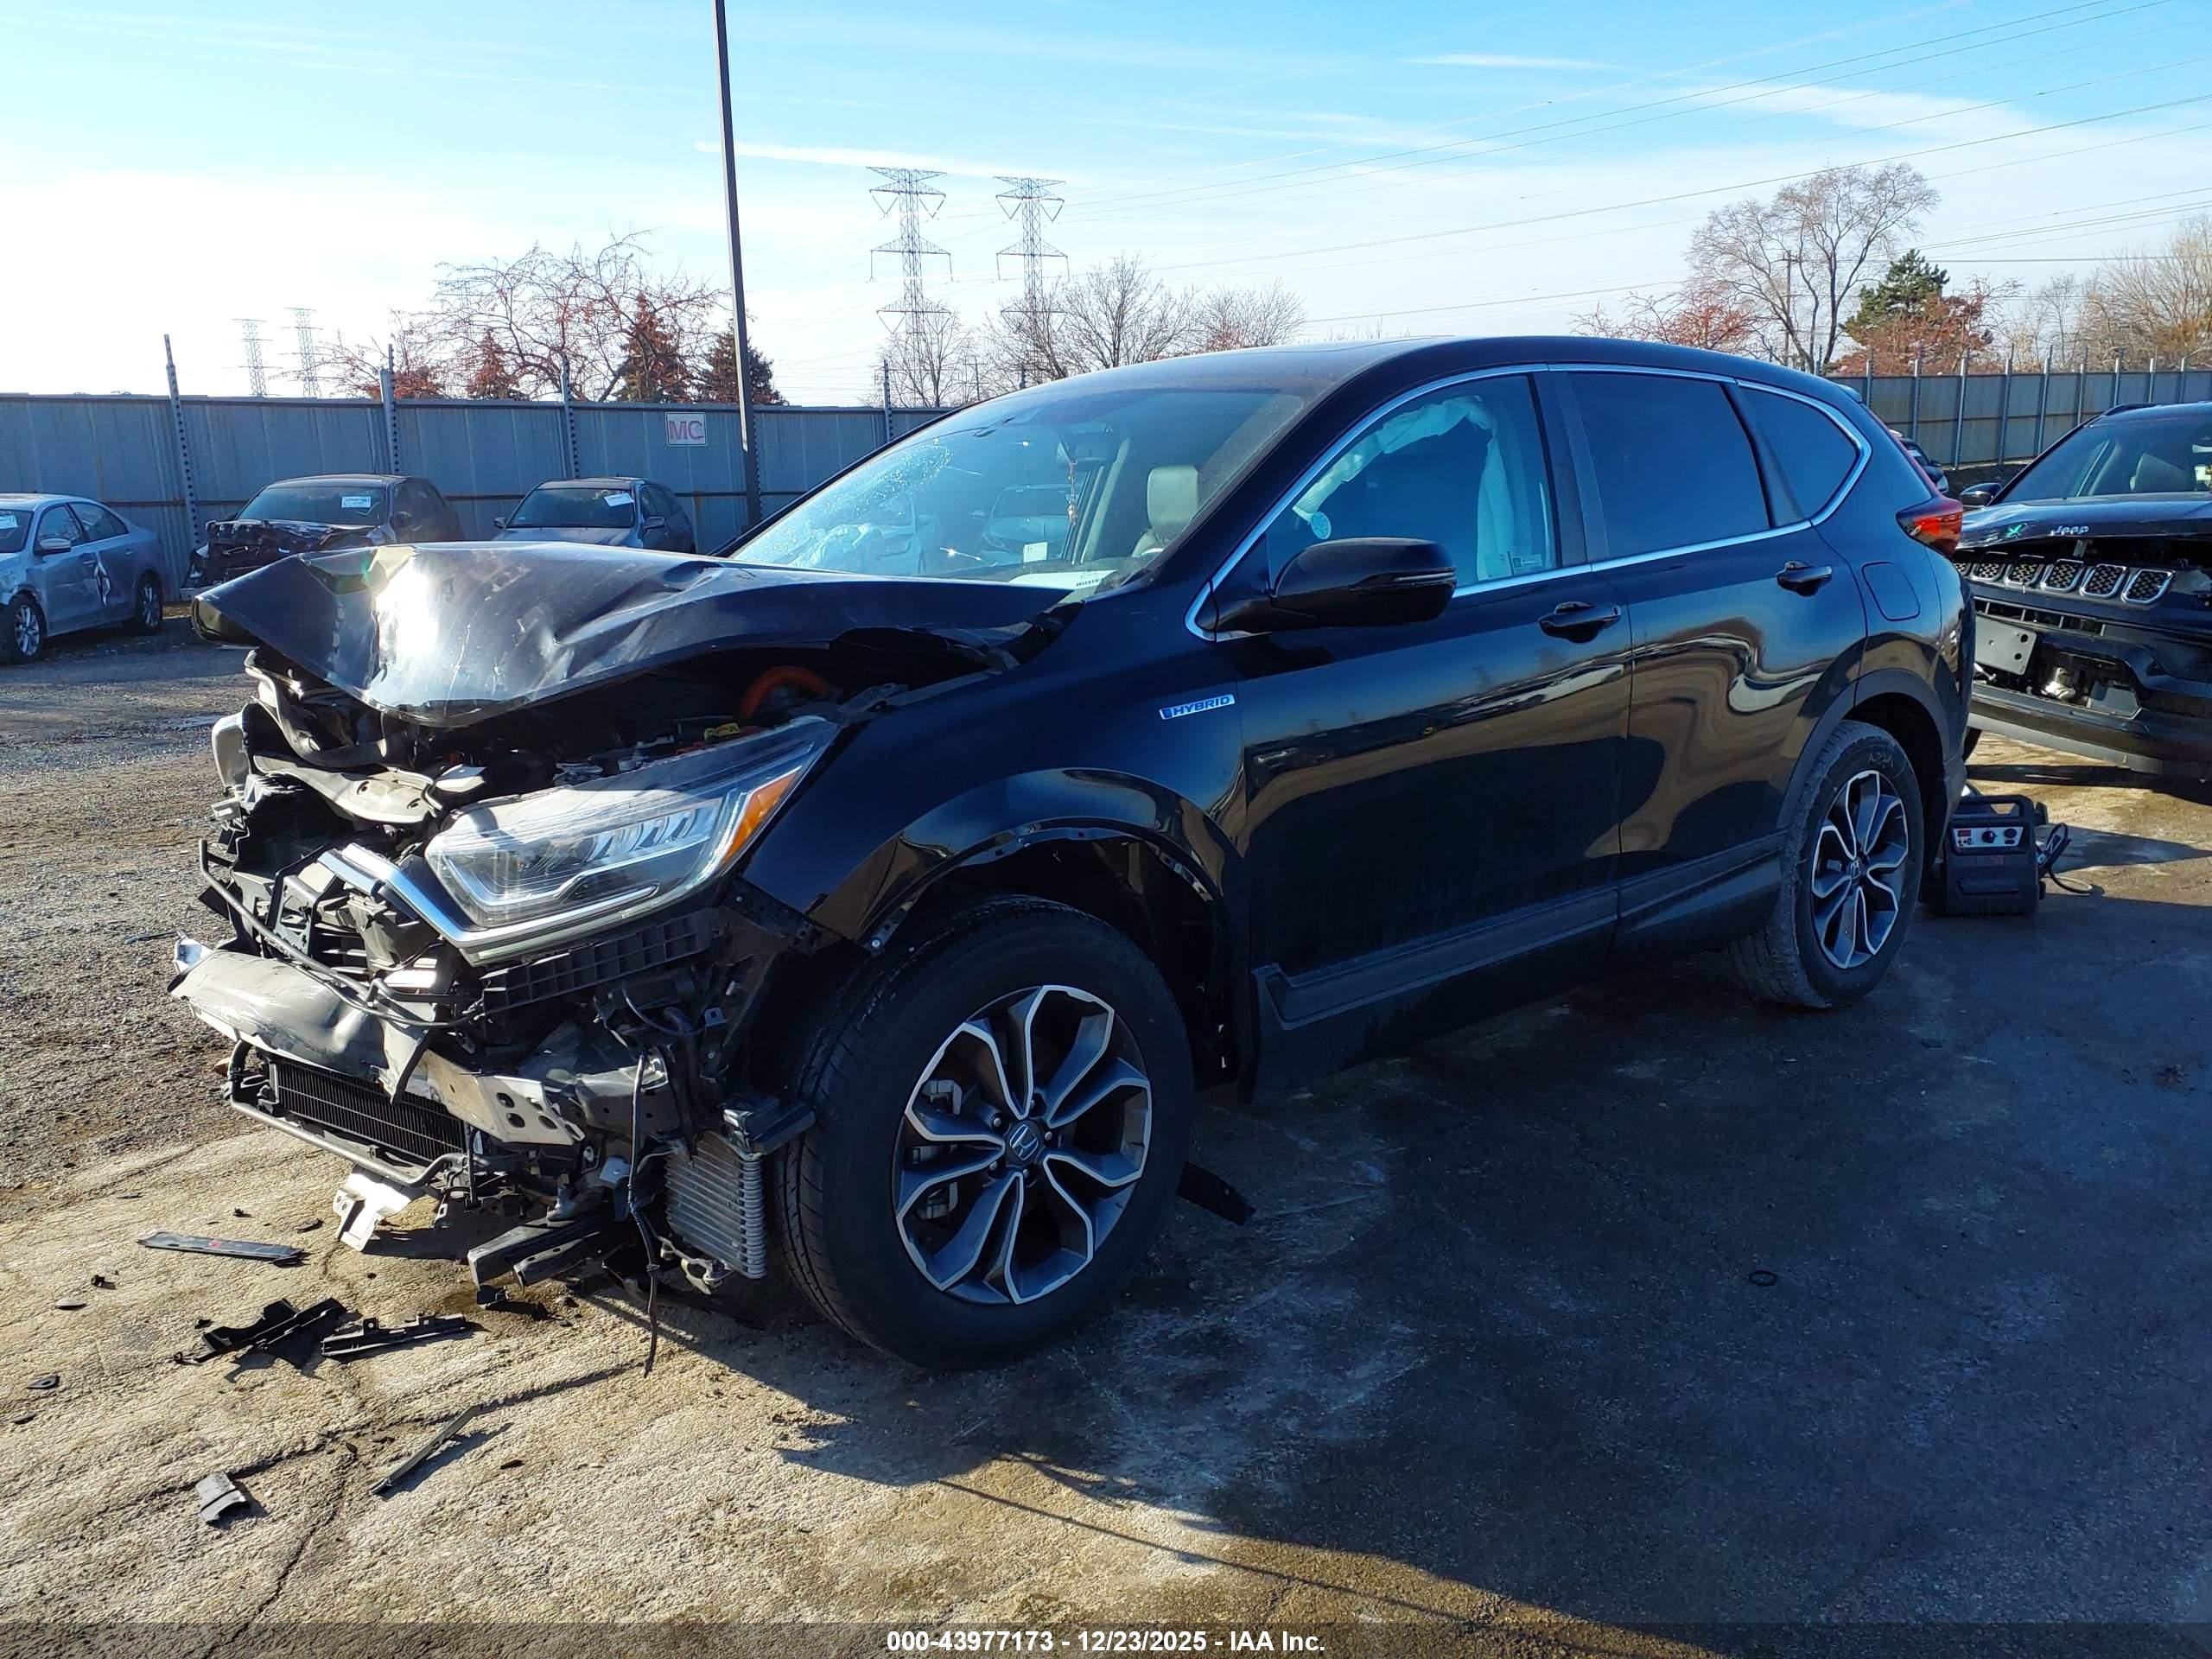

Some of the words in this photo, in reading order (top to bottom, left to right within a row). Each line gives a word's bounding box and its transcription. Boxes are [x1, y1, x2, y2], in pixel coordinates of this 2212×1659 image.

[669, 420, 704, 440] MC
[2050, 524, 2089, 536] Jeep
[1172, 696, 1231, 716] HYBRID
